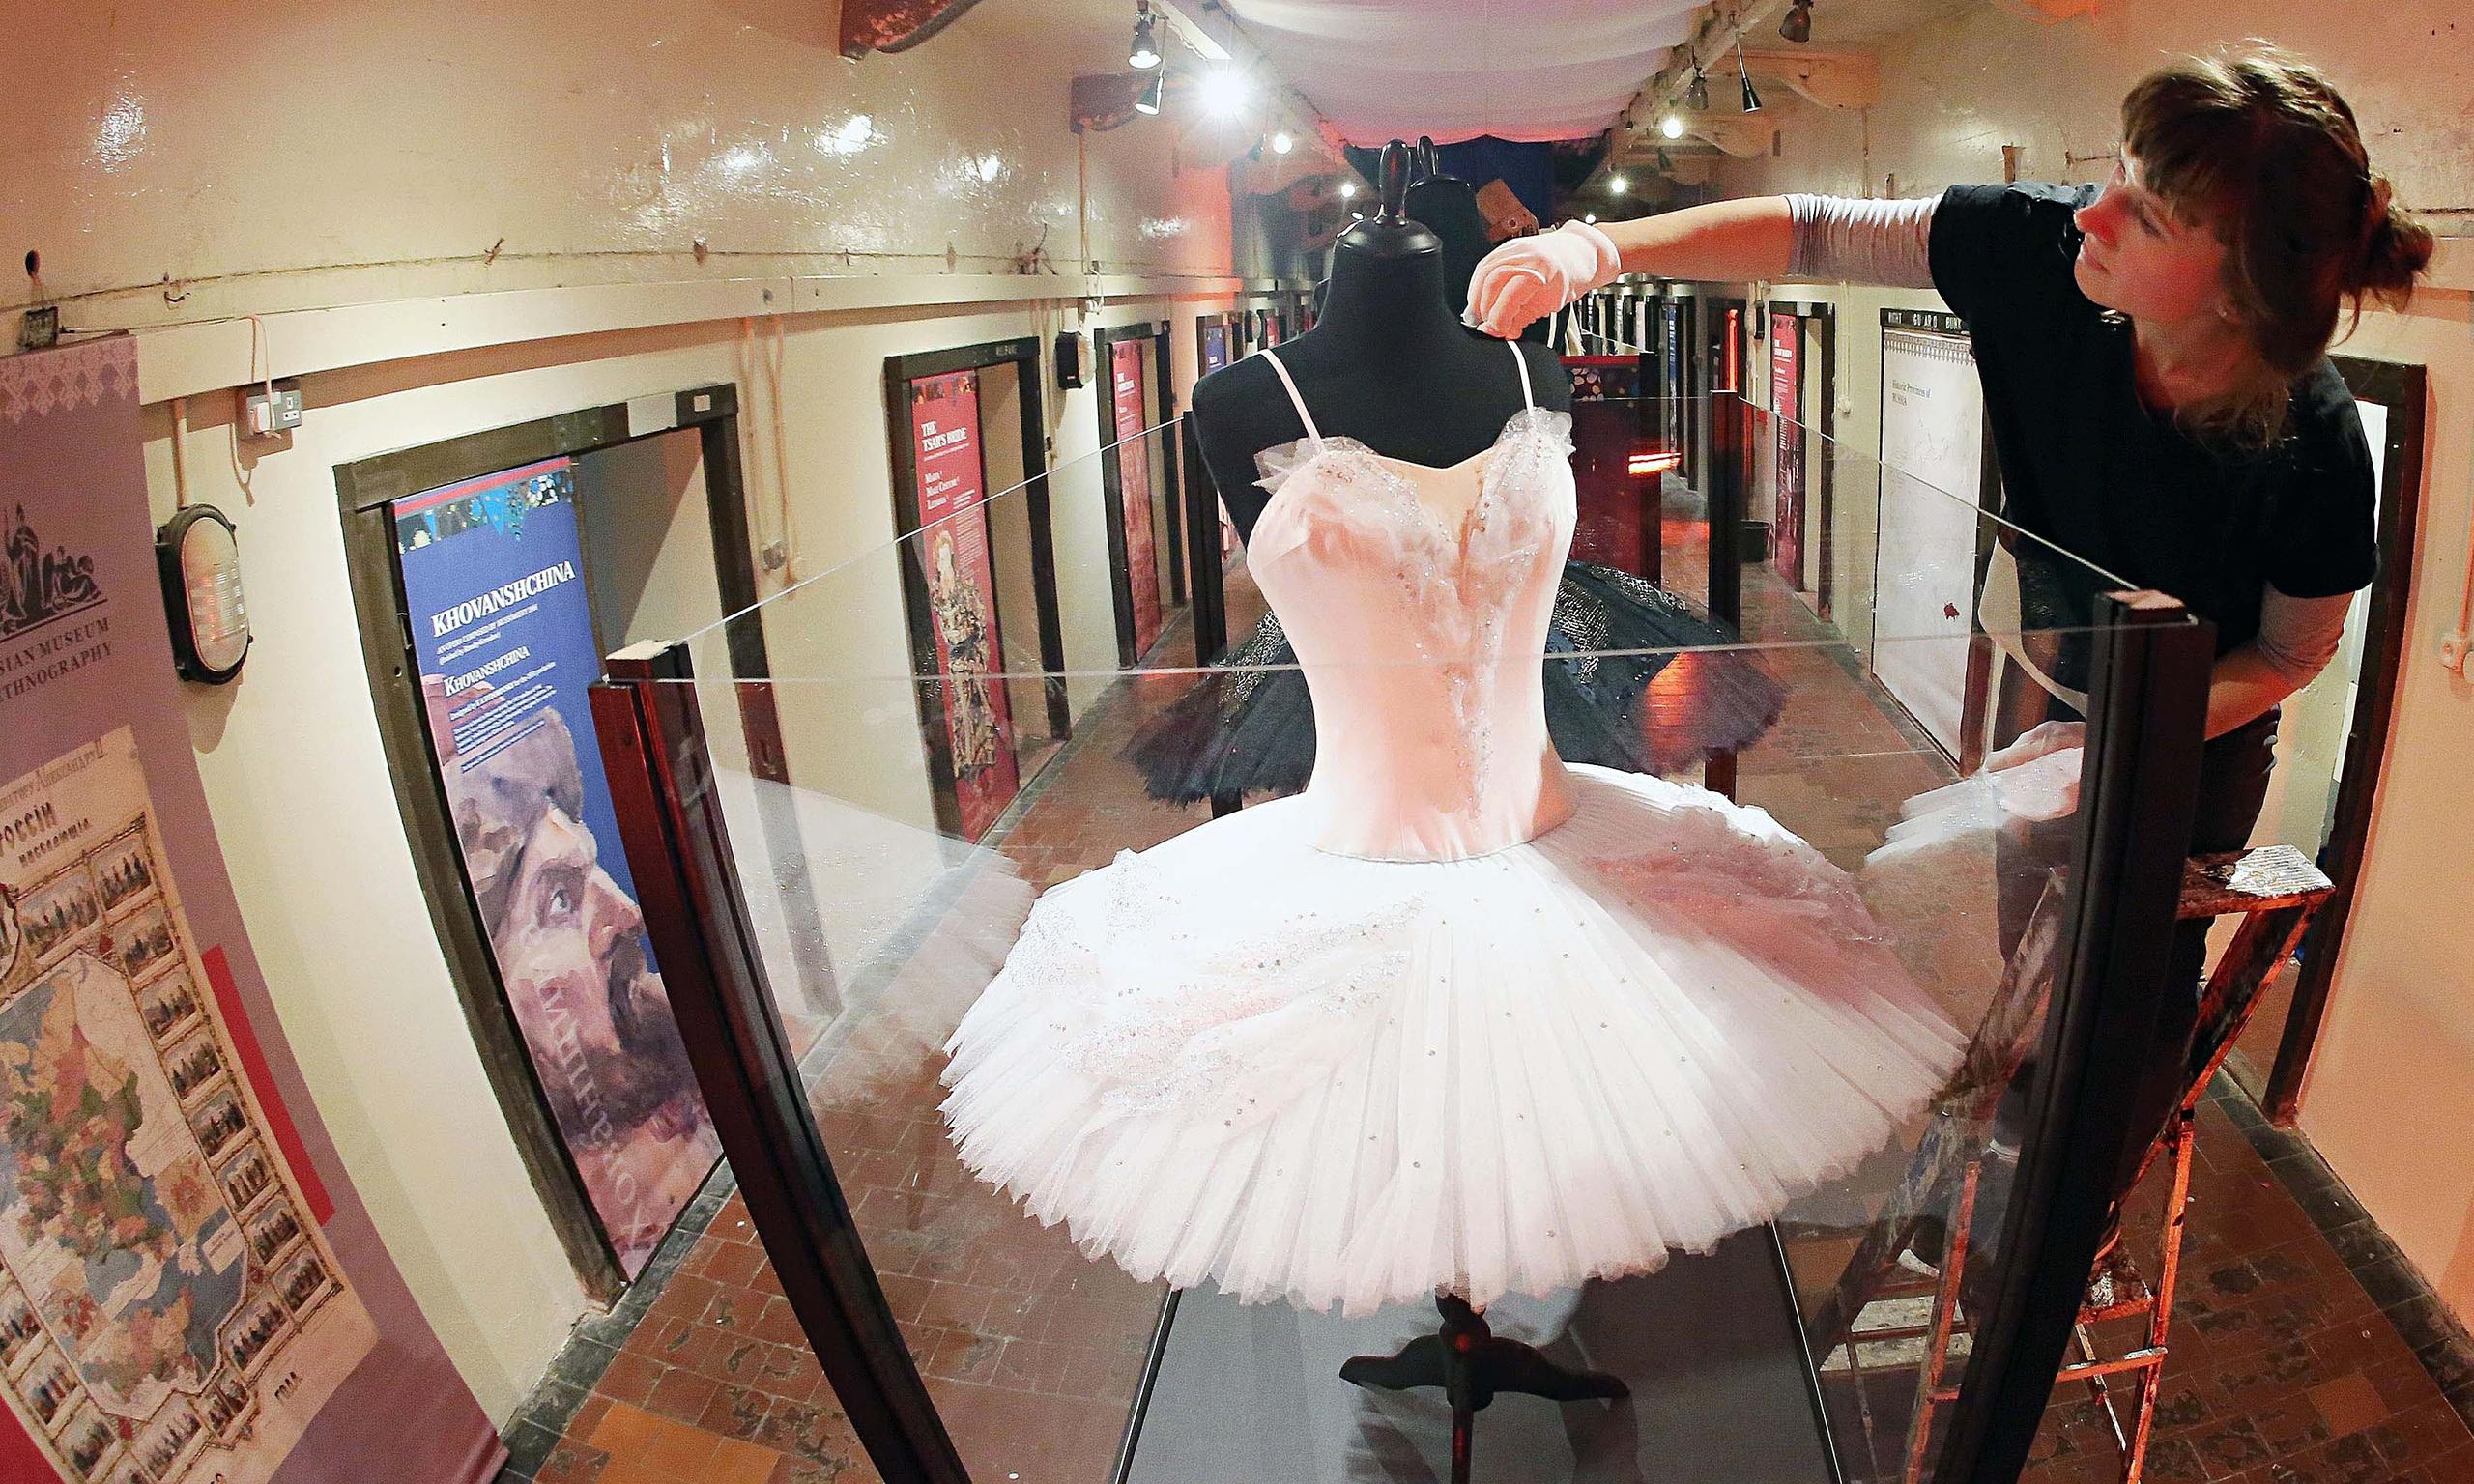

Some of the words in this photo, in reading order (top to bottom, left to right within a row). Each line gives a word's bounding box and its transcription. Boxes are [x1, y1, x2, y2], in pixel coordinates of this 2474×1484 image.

[431, 560, 575, 638] KHOVANSHCHINA
[39, 617, 109, 657] MUSEUM
[0, 641, 113, 702] THNOGRAPHY
[444, 645, 530, 697] KHOVANSHCHINA
